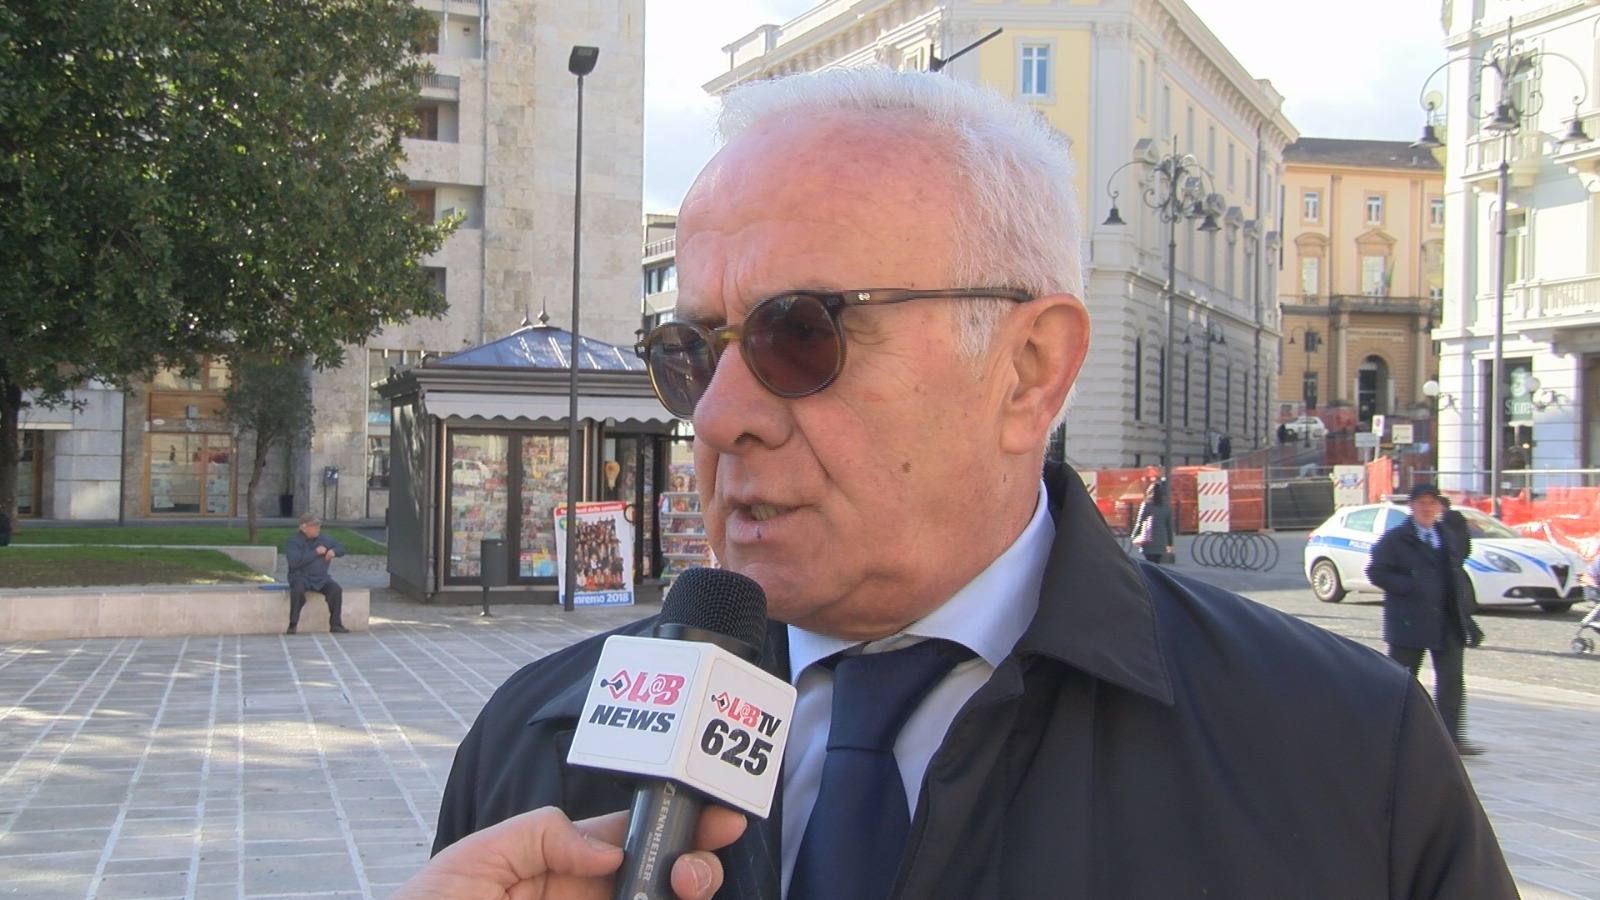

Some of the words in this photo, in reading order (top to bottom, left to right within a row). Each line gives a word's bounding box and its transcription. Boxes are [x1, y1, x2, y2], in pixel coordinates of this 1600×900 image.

[606, 592, 629, 603] 2018
[588, 704, 676, 734] NEWS
[700, 718, 774, 776] 625
[642, 798, 671, 881] SENNHEISER
